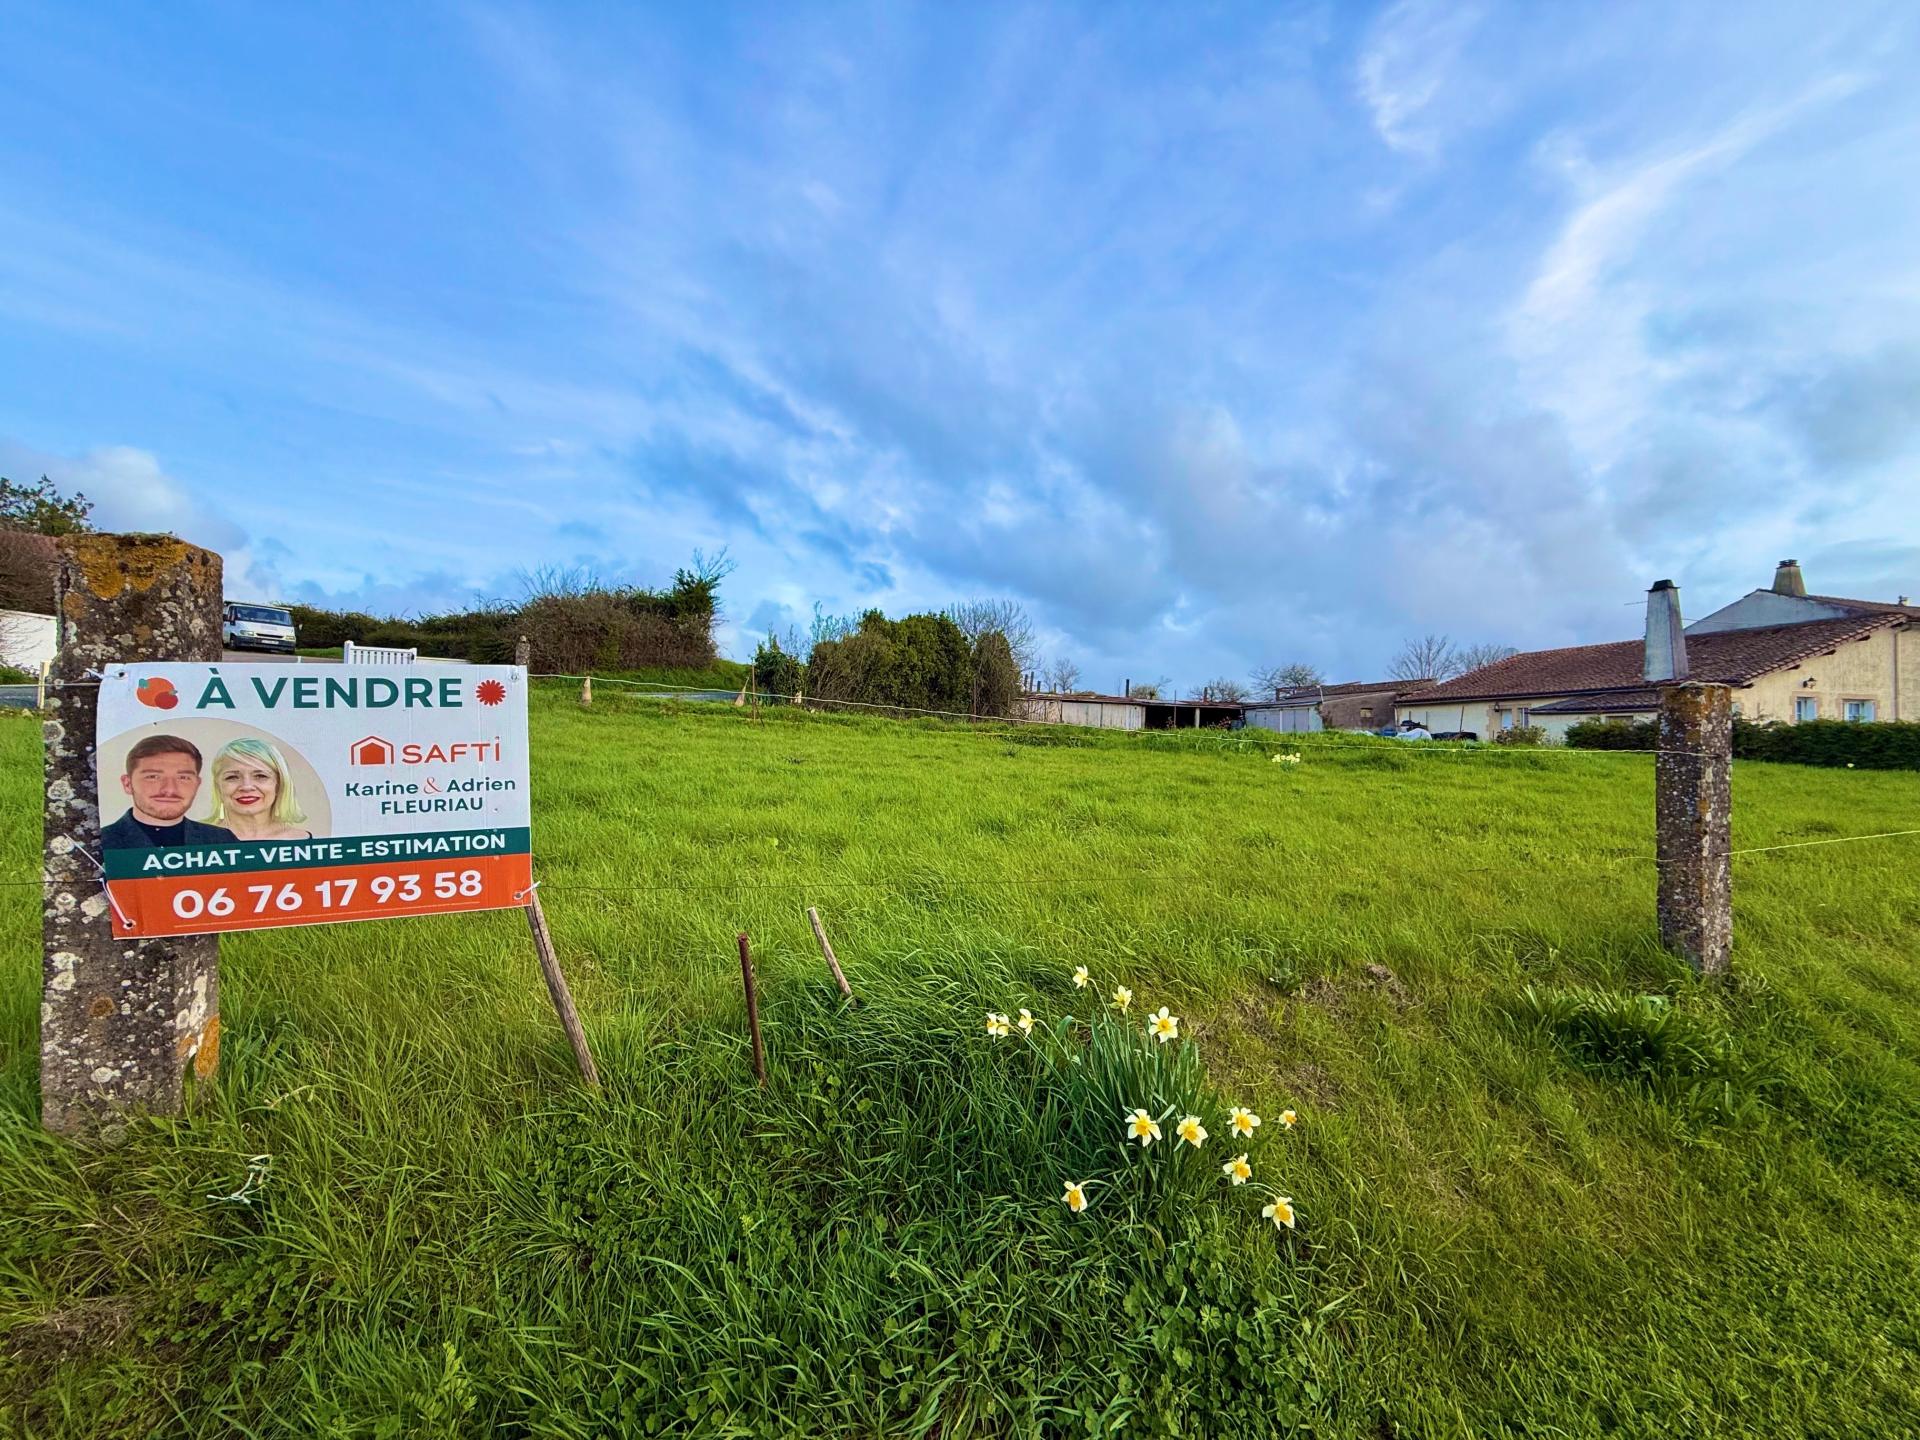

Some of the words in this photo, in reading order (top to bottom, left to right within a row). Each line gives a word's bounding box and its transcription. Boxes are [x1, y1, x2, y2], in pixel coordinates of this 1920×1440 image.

[196, 667, 236, 709] À
[251, 677, 463, 709] VENDRE
[345, 780, 419, 797] Karine
[423, 777, 443, 795] &
[446, 777, 516, 793] Adrien
[381, 797, 483, 815] FLEURIAU
[361, 833, 506, 857] ESTIMATION
[172, 888, 236, 919] 06
[248, 883, 303, 913] 76
[314, 878, 358, 908] 17
[370, 874, 422, 903] 93
[434, 870, 483, 899] 58
